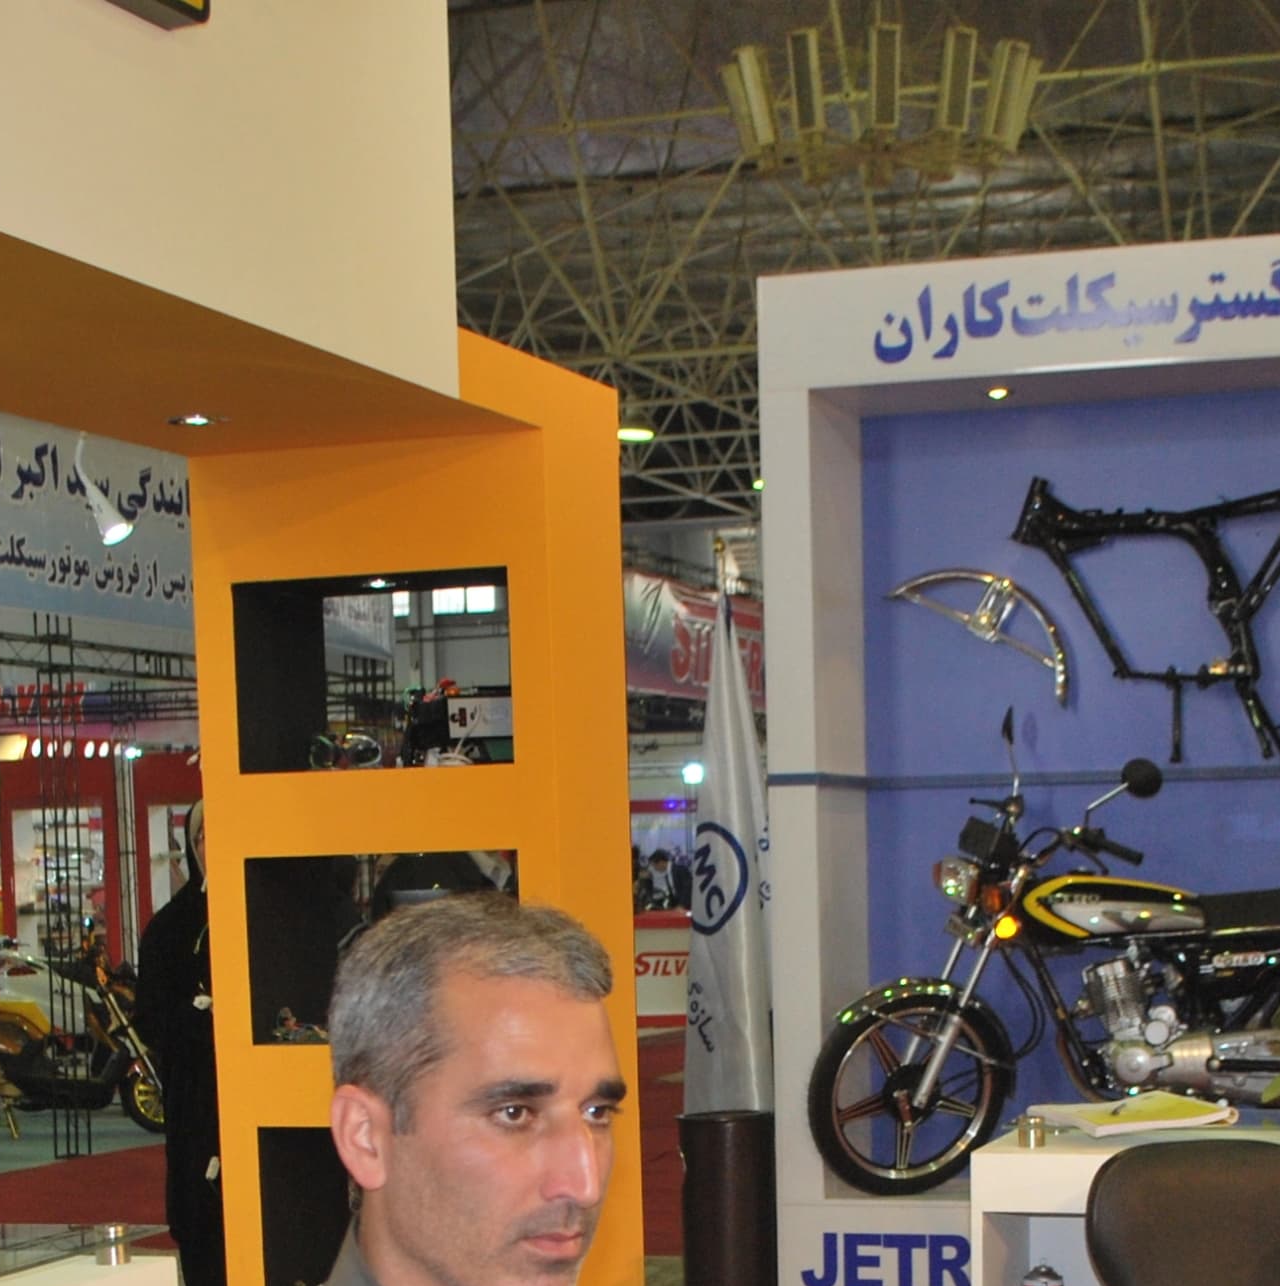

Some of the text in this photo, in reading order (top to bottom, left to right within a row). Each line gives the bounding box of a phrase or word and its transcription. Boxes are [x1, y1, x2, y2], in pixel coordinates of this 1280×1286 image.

[873, 279, 1011, 364] کاران
[1011, 271, 1179, 348] سیکلت
[11, 443, 59, 500] اکبر
[95, 552, 141, 597] فروش
[144, 559, 158, 598] از
[162, 571, 187, 604] پس
